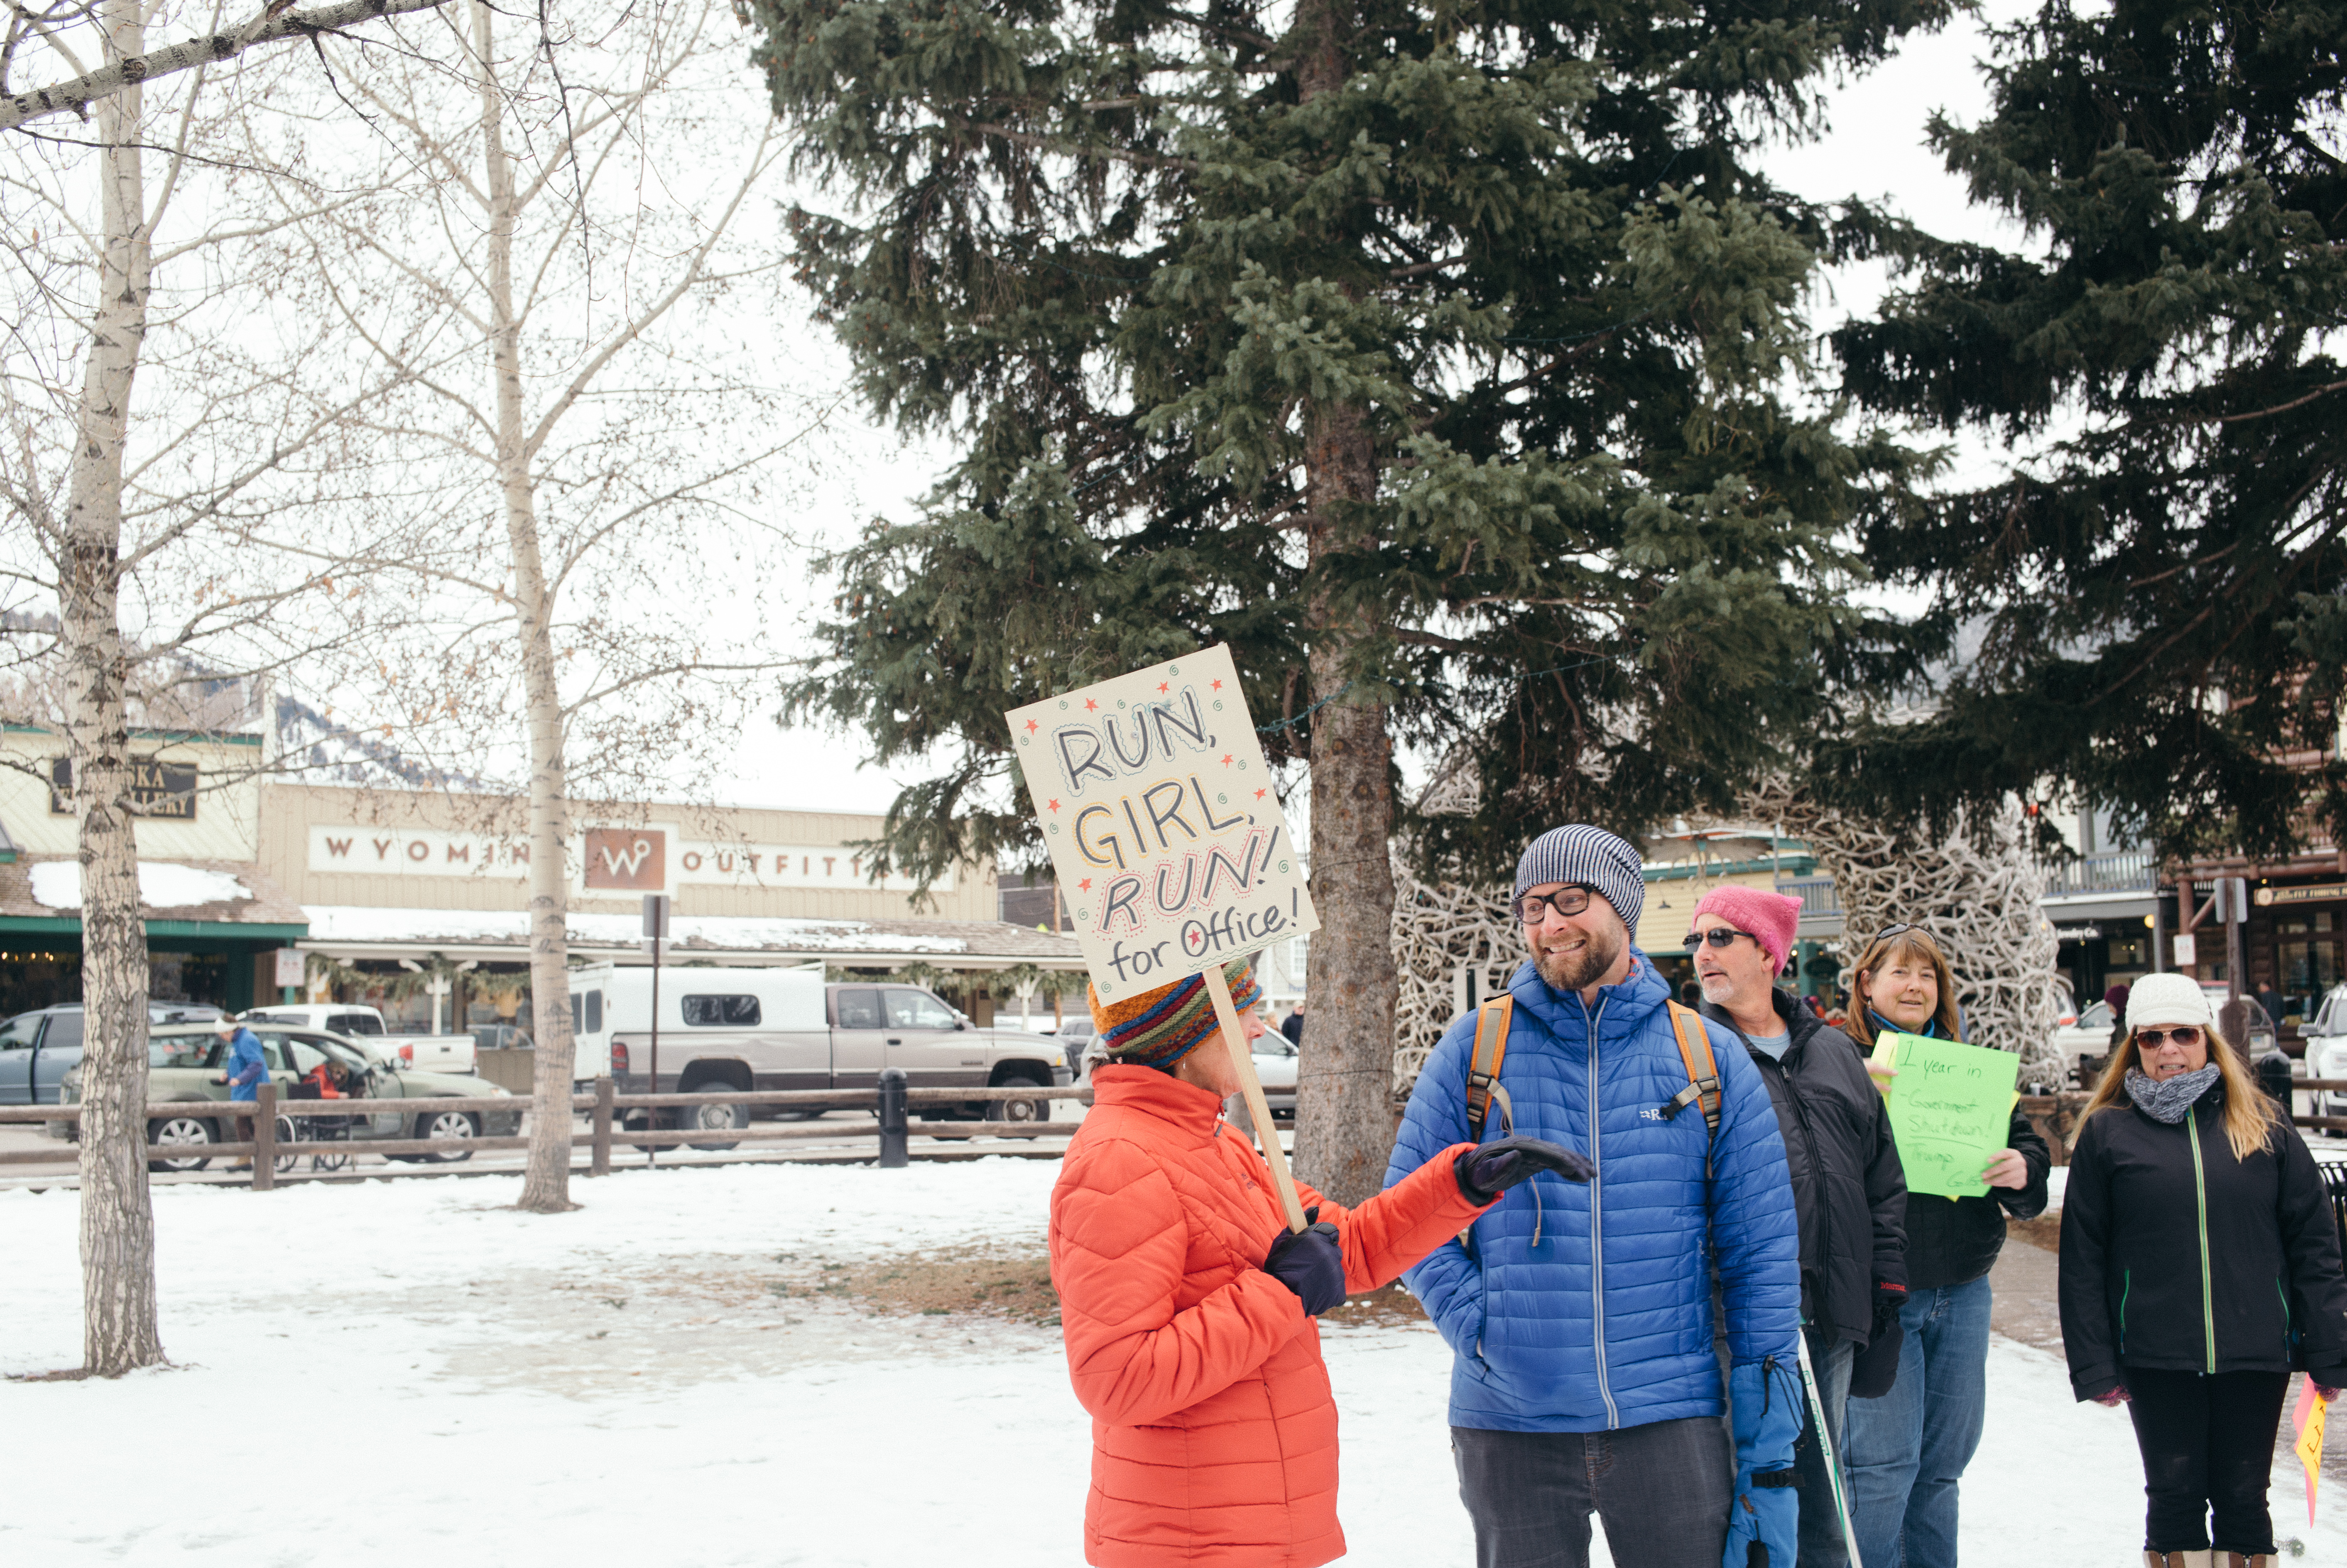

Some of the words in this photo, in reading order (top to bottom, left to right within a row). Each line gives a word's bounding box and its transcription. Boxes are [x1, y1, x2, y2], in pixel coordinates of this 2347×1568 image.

[1055, 688, 1216, 794] RUN,
[326, 837, 531, 864] WYOMIN
[683, 850, 942, 879] OUTFITT
[1073, 775, 1254, 870] GIRL,
[1100, 826, 1279, 932] RUN!
[1107, 941, 1170, 981] for
[1181, 887, 1297, 957] Office!
[1924, 1060, 1957, 1080] year
[1967, 1063, 1981, 1078] in
